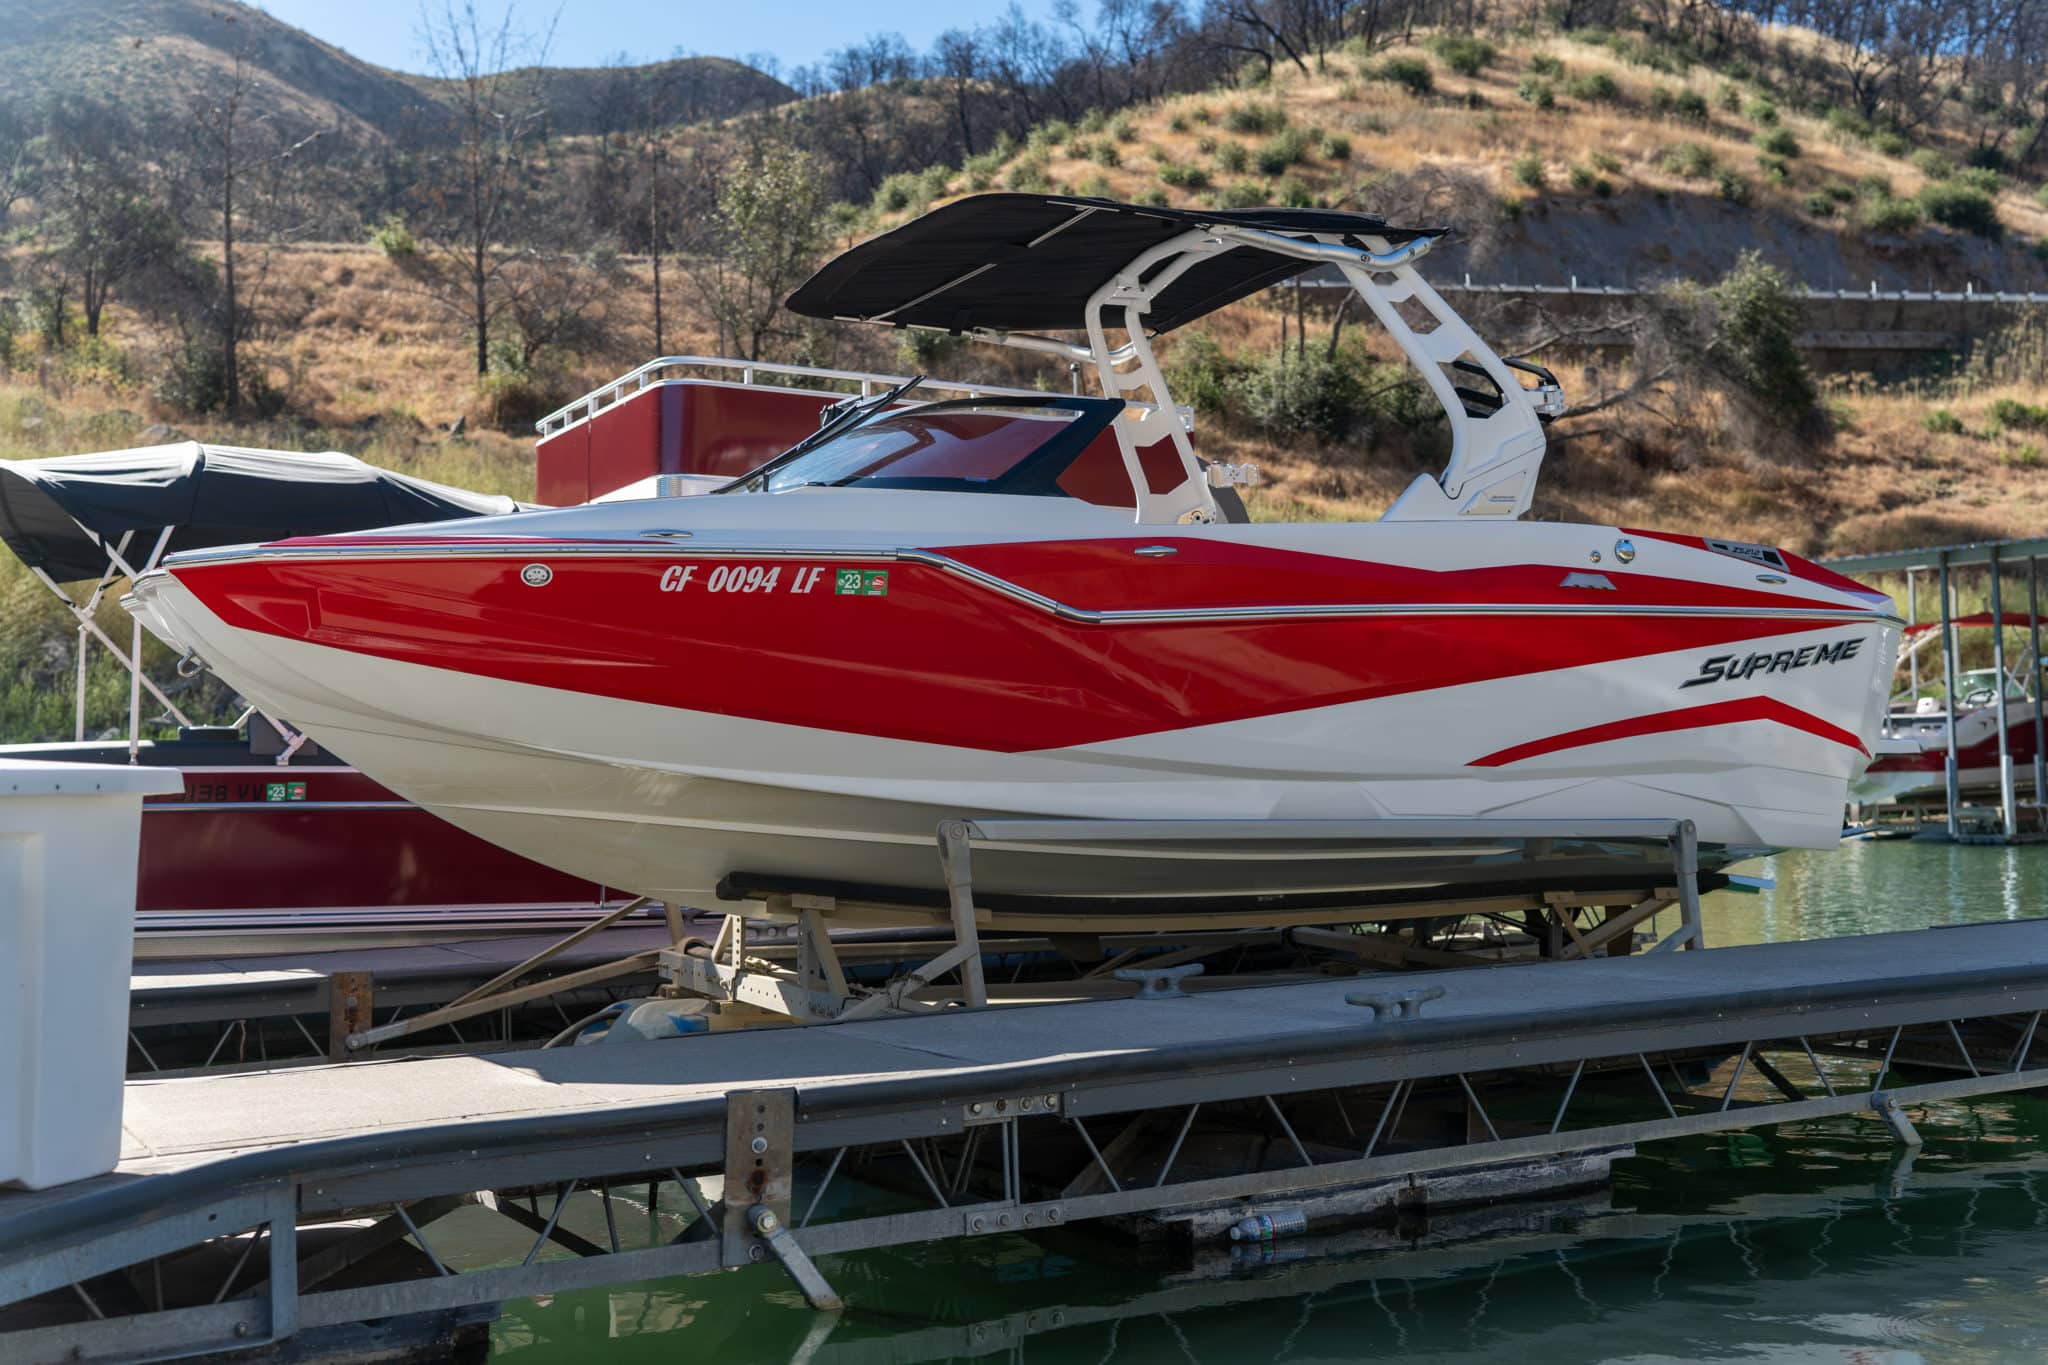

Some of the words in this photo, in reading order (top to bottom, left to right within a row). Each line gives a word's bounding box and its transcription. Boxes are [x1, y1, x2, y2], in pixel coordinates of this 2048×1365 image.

[659, 565, 698, 592] CF
[707, 566, 782, 593] 0094
[790, 567, 825, 594] LF
[844, 574, 861, 589] 23
[1678, 637, 1866, 689] SUPREME
[272, 786, 286, 798] 23
